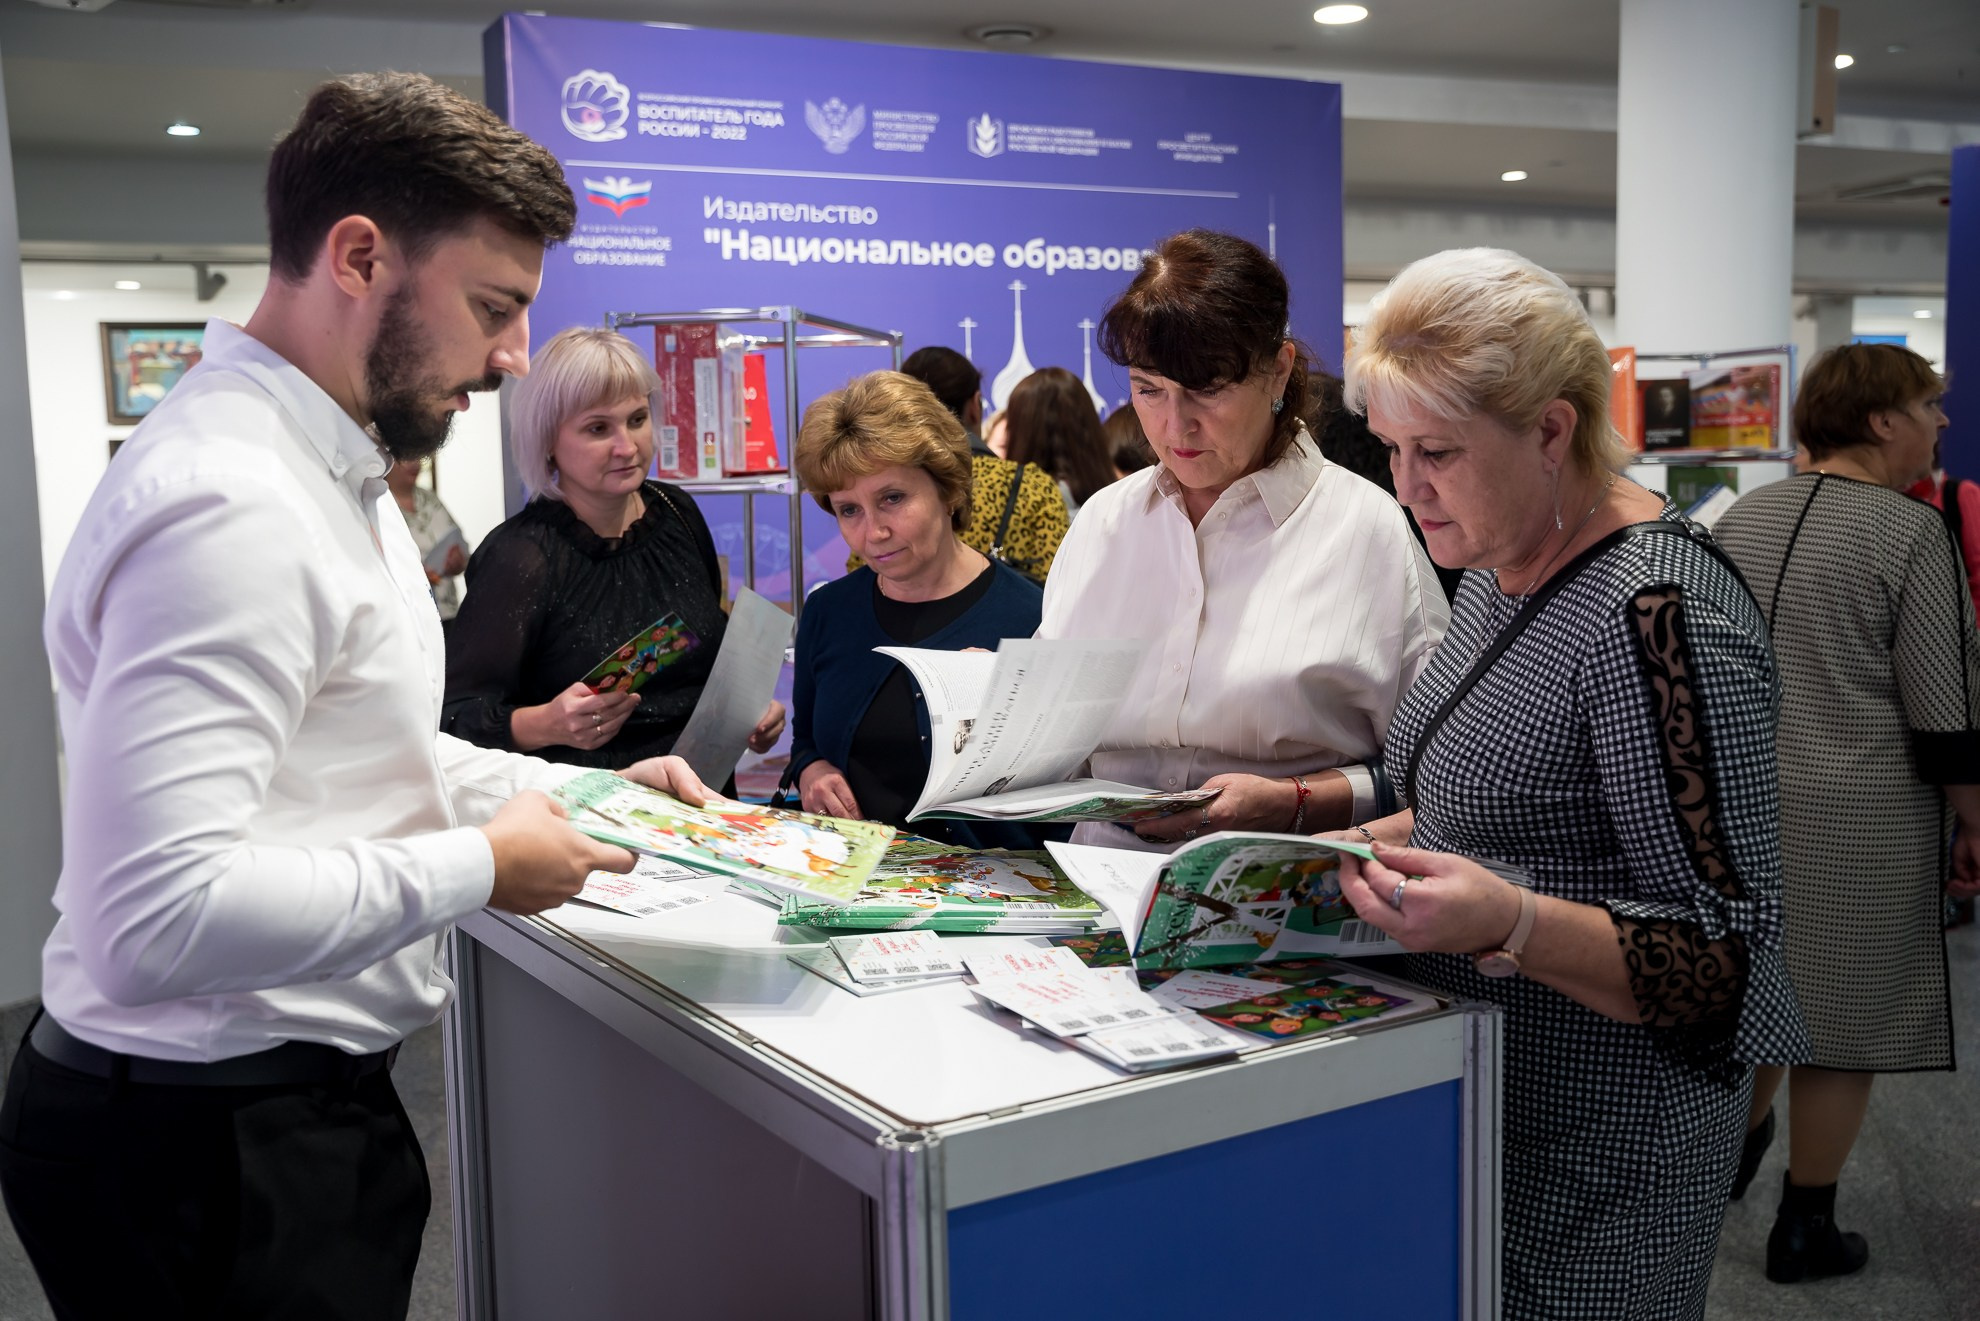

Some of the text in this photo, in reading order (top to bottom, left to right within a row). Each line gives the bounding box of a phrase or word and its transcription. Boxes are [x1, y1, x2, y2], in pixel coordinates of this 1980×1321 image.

[637, 103, 785, 128] ВОСПИТАТЕЛЬ ГОДА
[638, 120, 700, 138] РОССИИ
[711, 123, 747, 140] 2022
[703, 195, 878, 225] Издательство
[573, 249, 666, 267] ОБРАЗОВАНИЕ
[703, 227, 1149, 276] "Национальное образов
